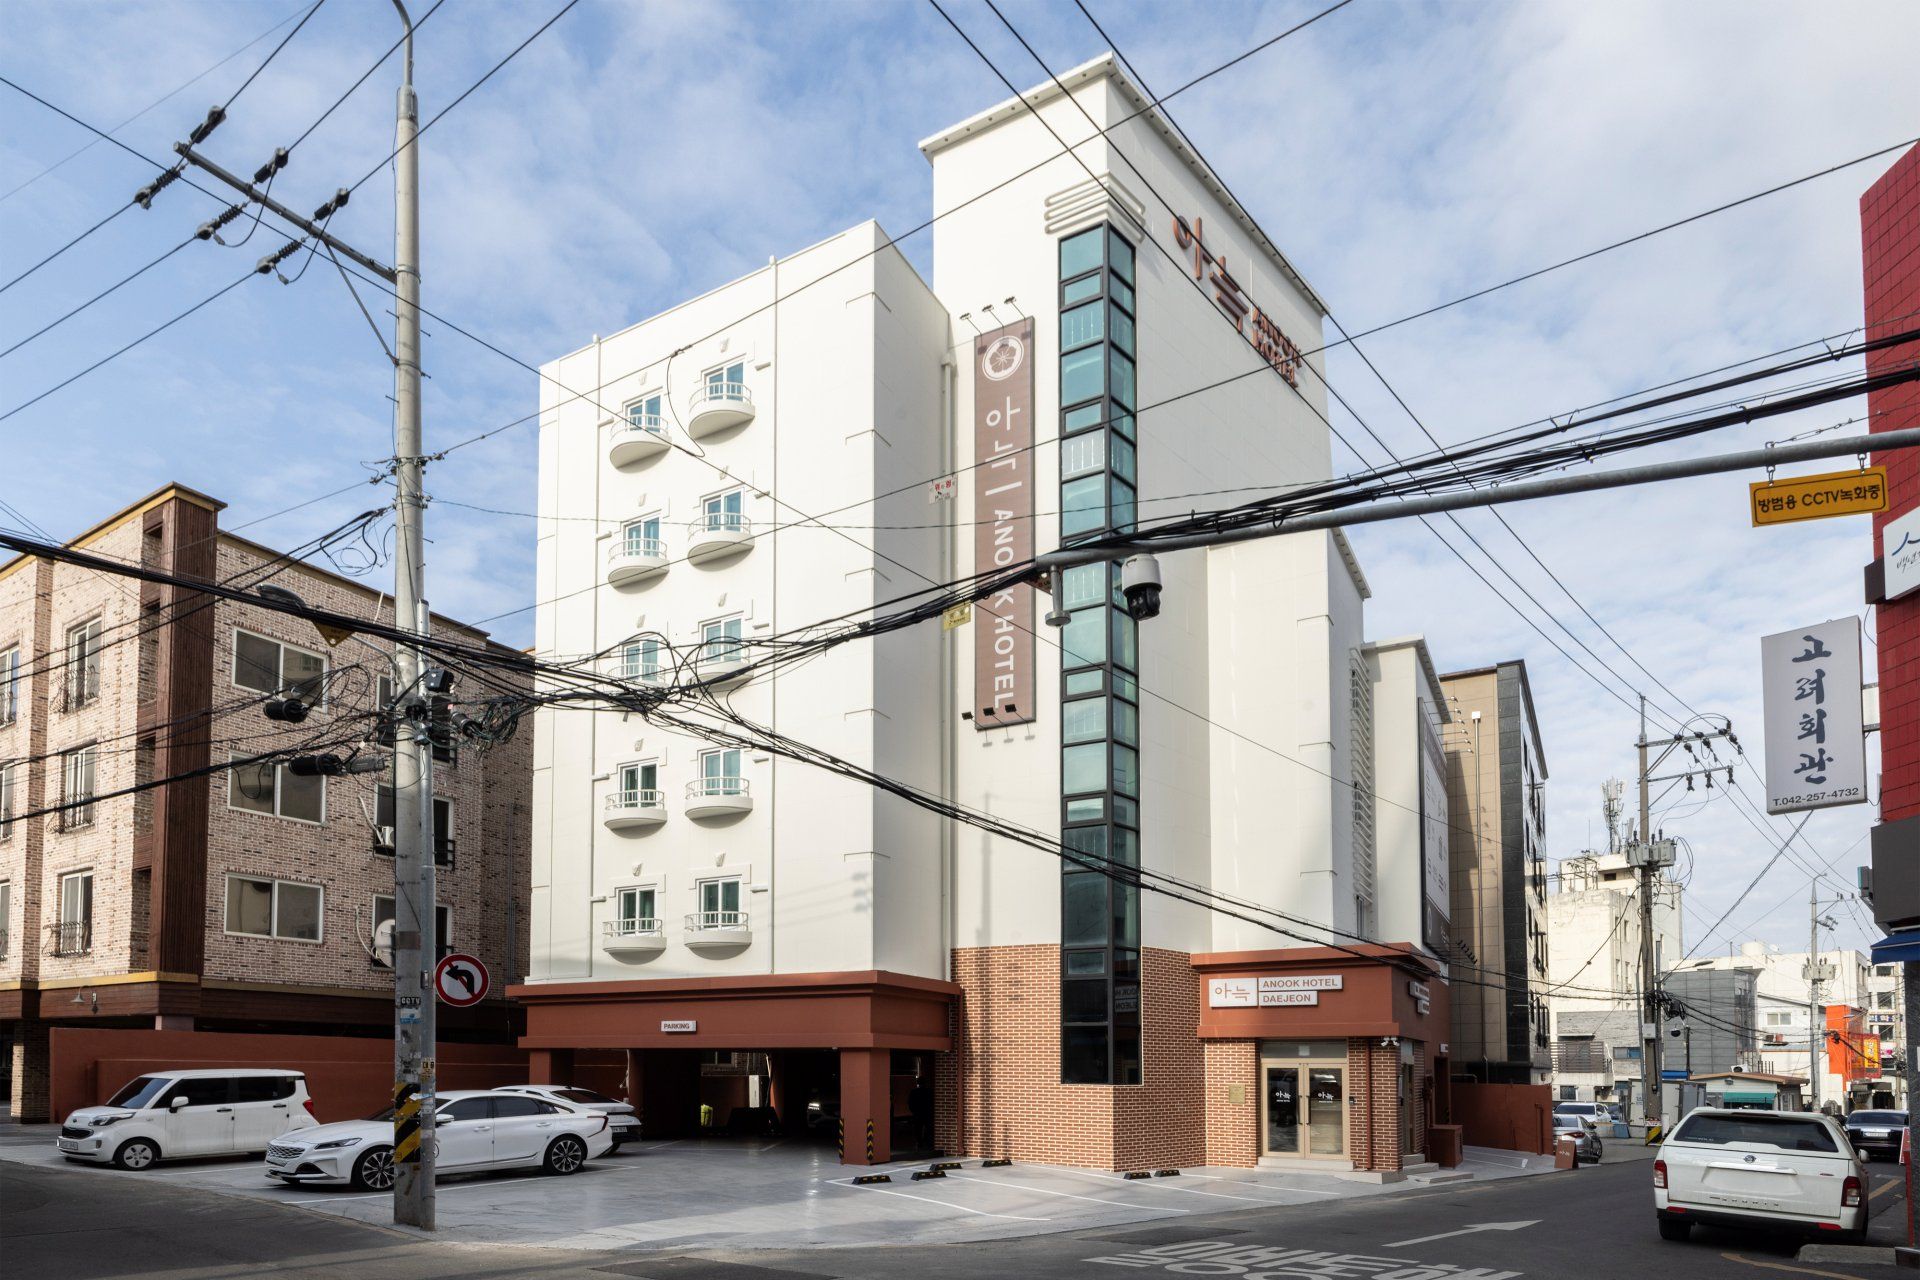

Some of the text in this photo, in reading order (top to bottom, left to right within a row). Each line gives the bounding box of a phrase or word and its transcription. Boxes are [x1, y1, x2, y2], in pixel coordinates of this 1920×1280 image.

[1757, 494, 1798, 514] 방범용
[985, 396, 1022, 710] 아늑 ANOK HOTEL
[1791, 634, 1834, 785] 고려회관
[1772, 786, 1860, 807] T.042-257-4732
[1214, 978, 1338, 1002] 아늑 ANOOK HOTEL
[1262, 994, 1312, 1003] DAEJEON
